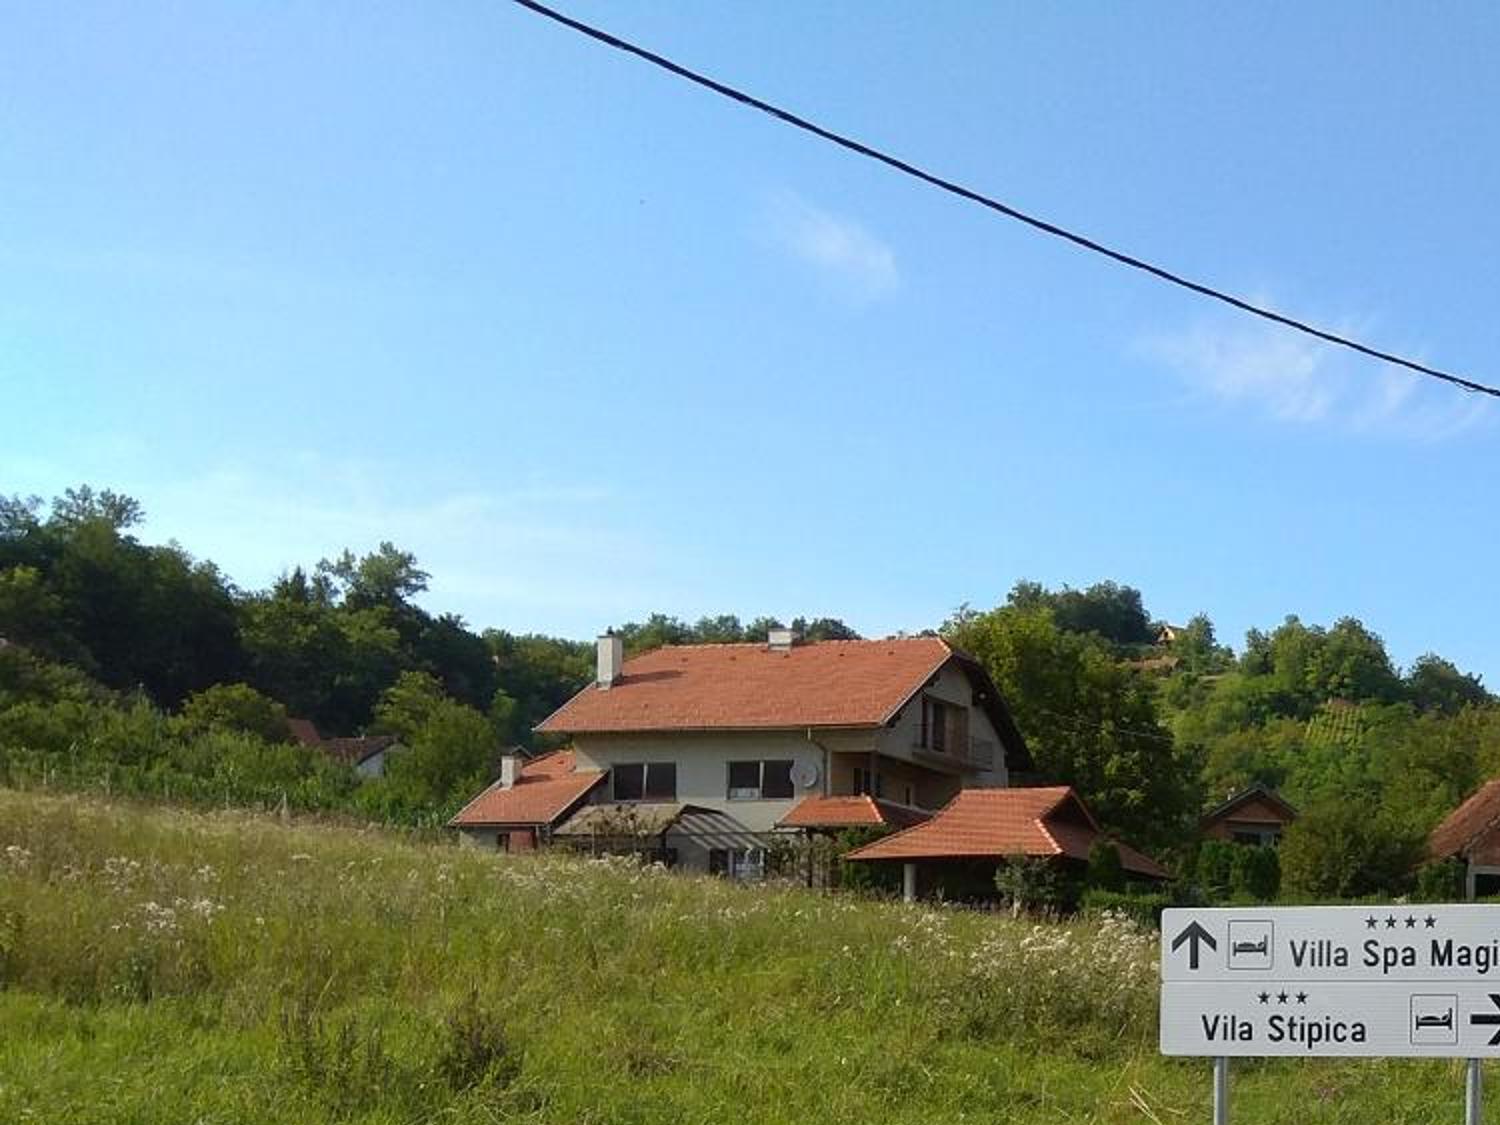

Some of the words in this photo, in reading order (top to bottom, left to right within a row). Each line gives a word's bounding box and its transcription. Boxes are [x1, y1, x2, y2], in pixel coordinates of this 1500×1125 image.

[1289, 939, 1349, 968] Villa
[1363, 939, 1417, 975] Spa
[1201, 1014, 1253, 1042] Vila
[1267, 1014, 1366, 1050] Stipica
